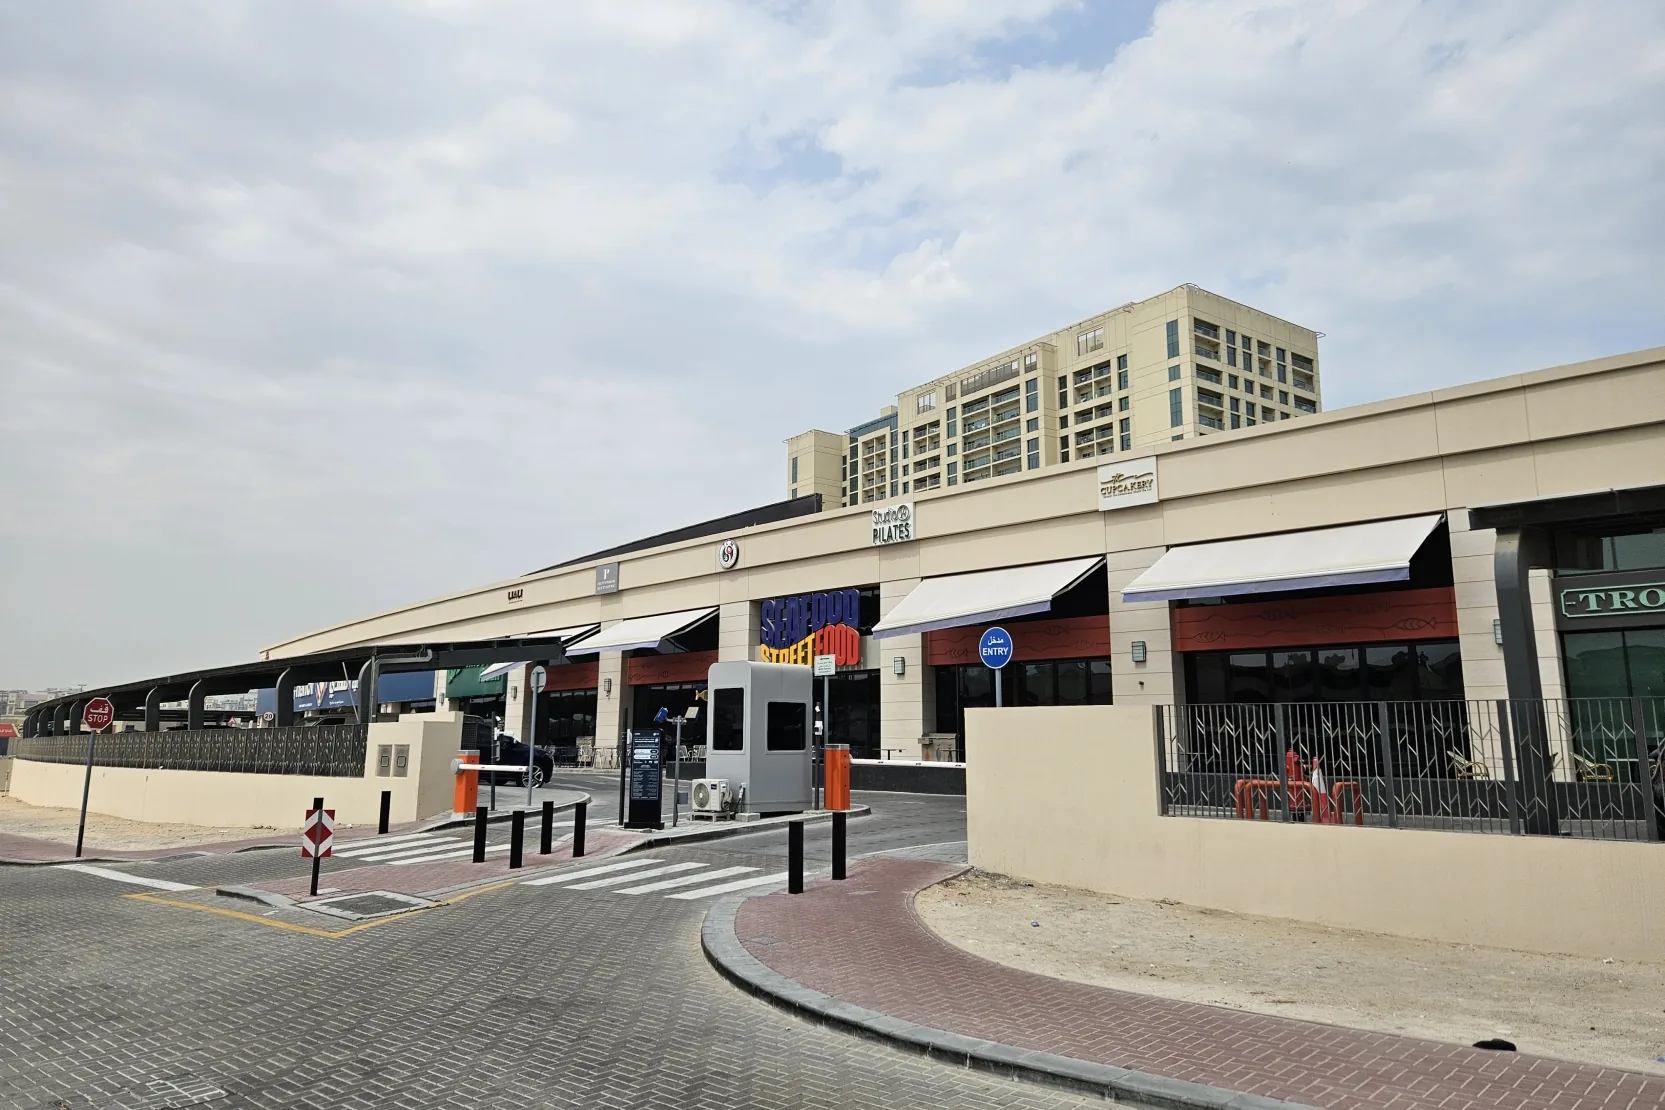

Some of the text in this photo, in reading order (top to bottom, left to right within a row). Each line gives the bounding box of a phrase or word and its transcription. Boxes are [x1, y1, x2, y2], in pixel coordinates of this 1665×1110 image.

[1100, 478, 1154, 496] CUPCAKERY
[873, 507, 898, 524] Studio
[872, 522, 911, 544] PILATES
[761, 589, 859, 649] SEAFOOD
[815, 624, 860, 666] FOOD
[987, 636, 1004, 646] مدخل
[982, 647, 1009, 656] ENTRY
[90, 703, 109, 713] قف
[87, 714, 109, 723] STOP
